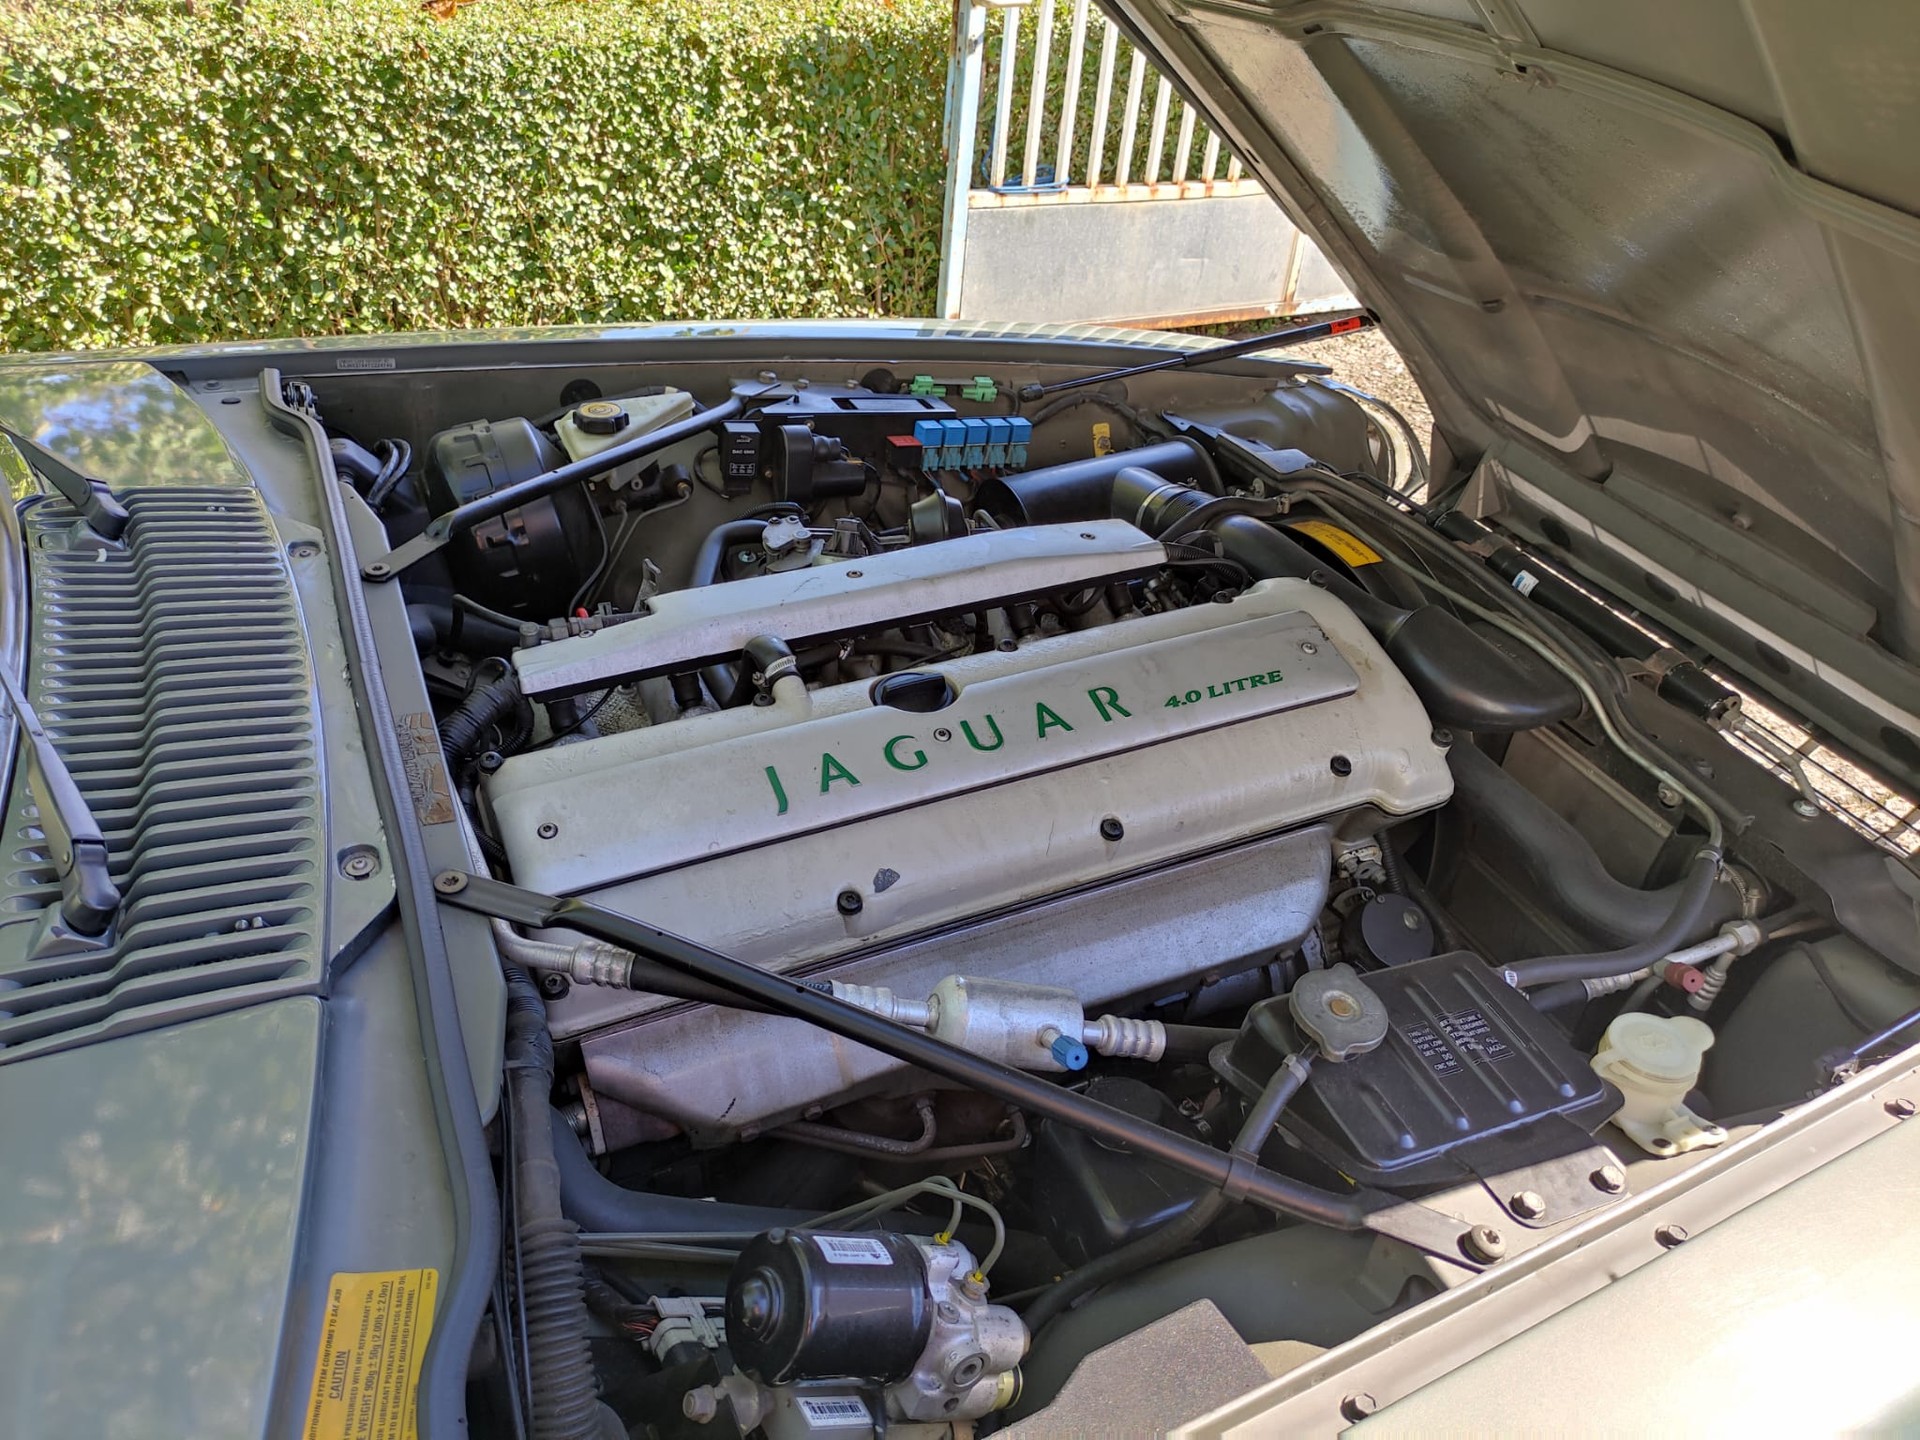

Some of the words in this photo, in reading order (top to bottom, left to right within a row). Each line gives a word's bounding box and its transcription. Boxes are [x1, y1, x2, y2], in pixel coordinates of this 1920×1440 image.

[765, 686, 1132, 815] JAGUAR
[1163, 688, 1203, 709] 4.0
[1208, 670, 1284, 700] LITRE
[378, 1281, 390, 1304] 2.0oz)
[396, 1286, 404, 1308] BASED
[403, 1289, 415, 1326] PERSONNEL
[371, 1315, 384, 1342] (2.00lb
[399, 1328, 409, 1362] QUALIFIED
[370, 1345, 381, 1360] 50g
[385, 1309, 401, 1384] POLYALKYLENEGLYCOL
[317, 1369, 328, 1398] SYSTEM
[323, 1329, 335, 1367] CONFORMS
[329, 1351, 347, 1399] CAUTION
[345, 1387, 359, 1436] PRESSURISED
[353, 1367, 361, 1385] WITH
[357, 1305, 372, 1350] REFRIGERANT
[397, 1364, 404, 1372] BY
[365, 1370, 377, 1391] 900g
[393, 1375, 403, 1408] SERVICED
[359, 1394, 372, 1432] WEIGHT
[379, 1386, 392, 1426] LUBRICANT
[391, 1411, 398, 1420] BE
[390, 1422, 397, 1431] TO
